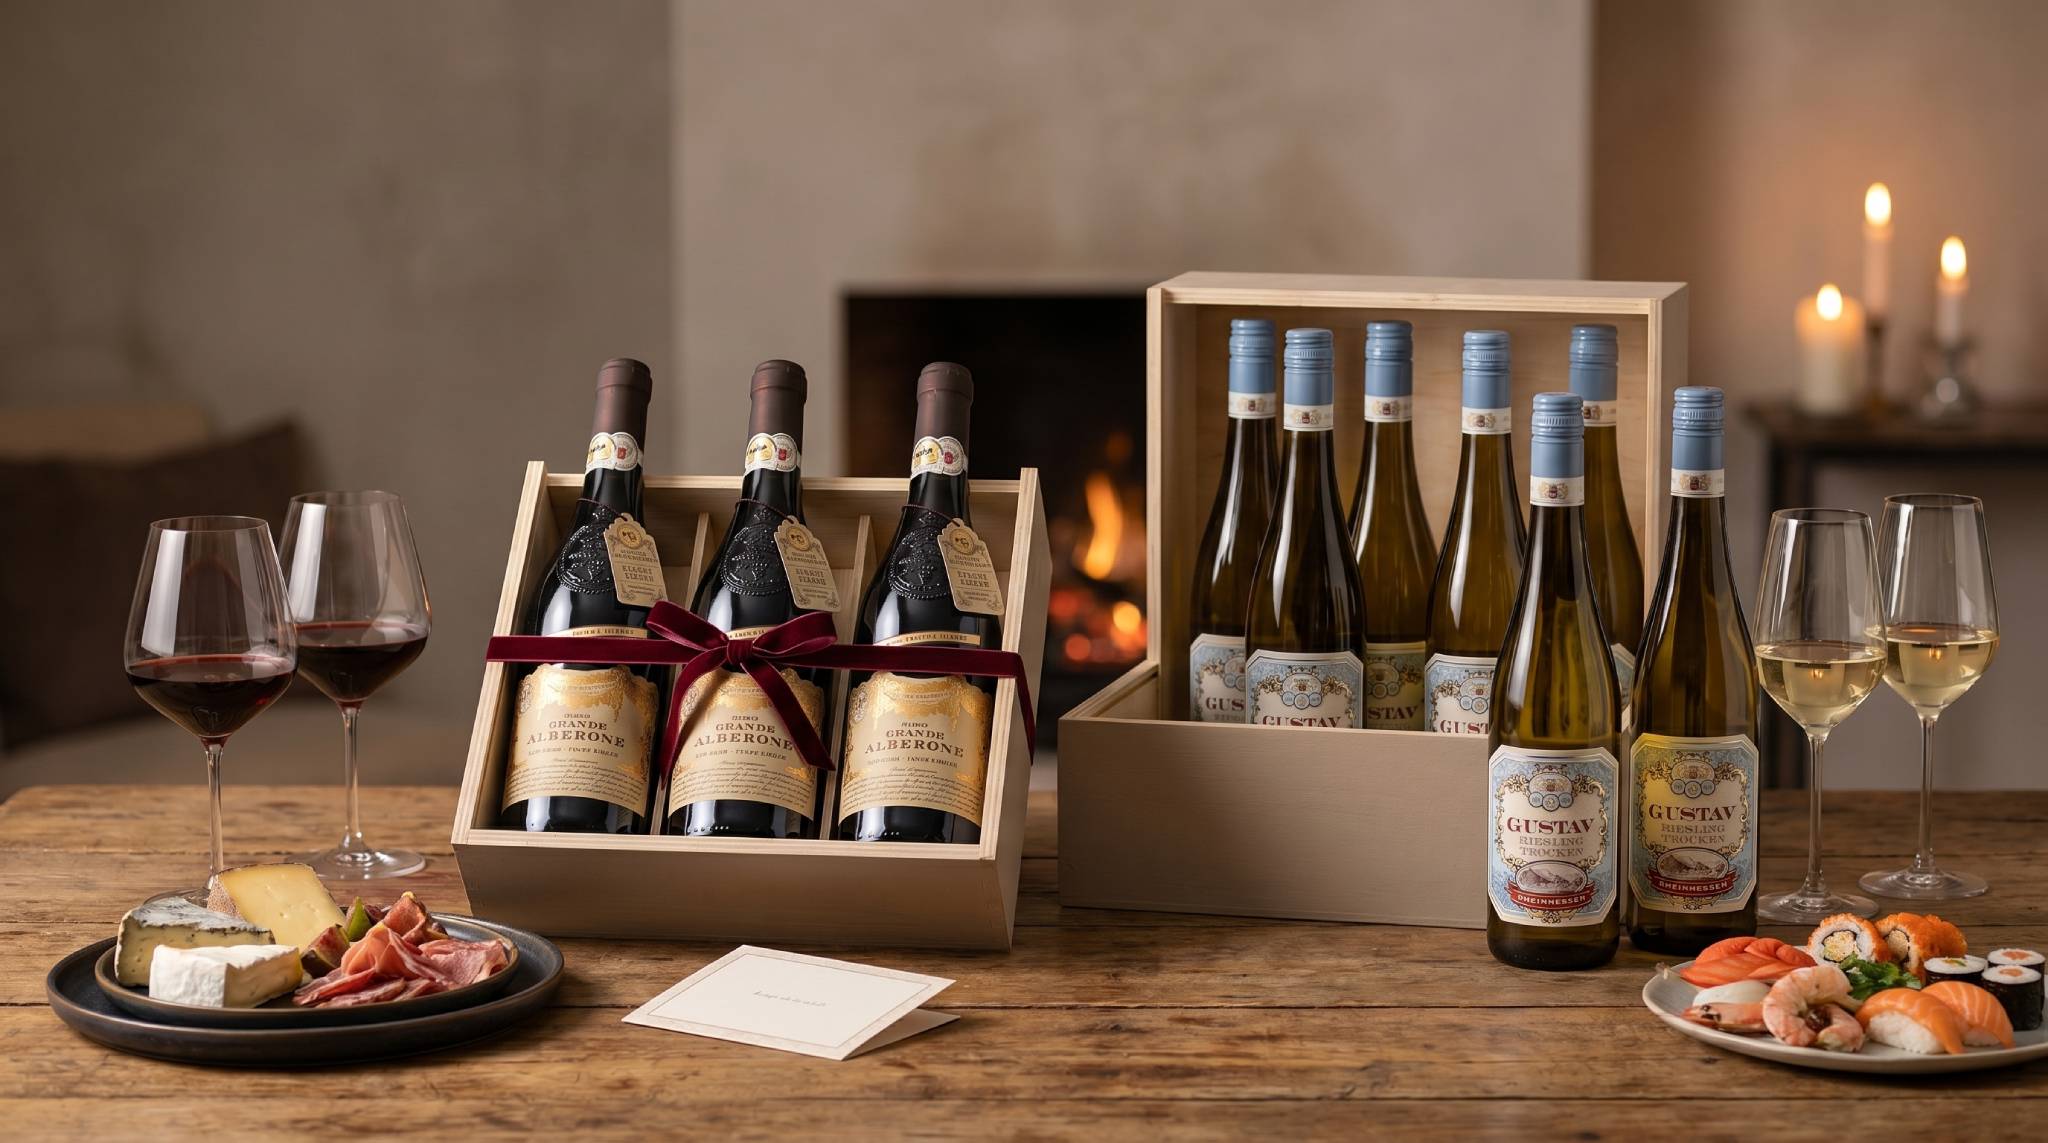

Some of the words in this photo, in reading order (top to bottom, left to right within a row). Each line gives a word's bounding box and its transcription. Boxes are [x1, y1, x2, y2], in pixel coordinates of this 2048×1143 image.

[1205, 696, 1245, 711] GUS
[1367, 705, 1418, 720] STAV
[548, 720, 607, 731] GRANDE
[715, 723, 776, 734] GRANDE
[1262, 715, 1340, 728] GUSTAV
[1440, 719, 1489, 734] GUST
[527, 730, 625, 748] ALBERONE
[693, 732, 793, 751] ALBERONE
[885, 729, 945, 740] GRANDE
[864, 739, 964, 758] ALBERONE
[1648, 803, 1737, 821] GUSTAV
[1506, 816, 1595, 835] GUSTAV
[1661, 823, 1725, 834] RIESLING
[1519, 835, 1584, 846] RIESLING
[1660, 833, 1725, 845] TROCKEN
[1519, 846, 1584, 858] TROCKEN
